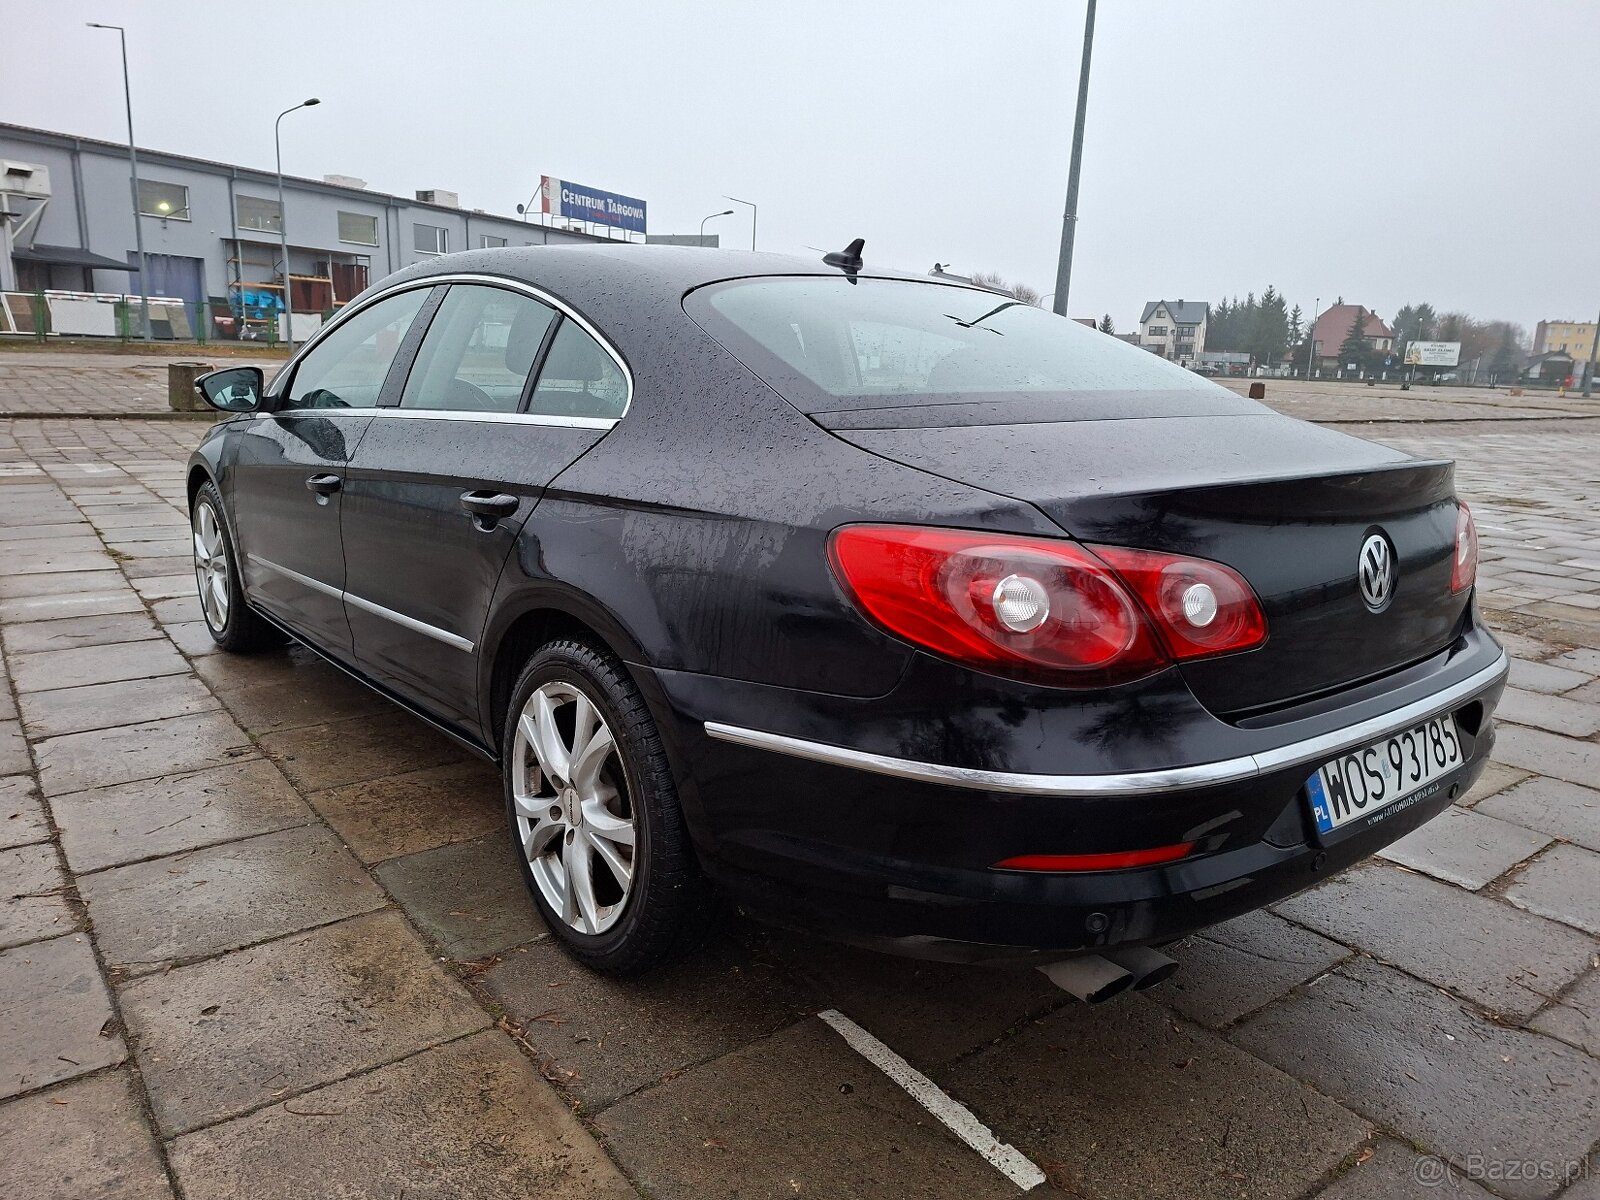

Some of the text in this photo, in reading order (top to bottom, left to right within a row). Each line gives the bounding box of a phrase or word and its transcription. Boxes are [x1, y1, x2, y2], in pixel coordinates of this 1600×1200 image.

[607, 198, 644, 219] TARGOWA
[1359, 534, 1391, 605] VW
[1322, 713, 1457, 819] WOS 93785
[1314, 806, 1328, 822] PL
